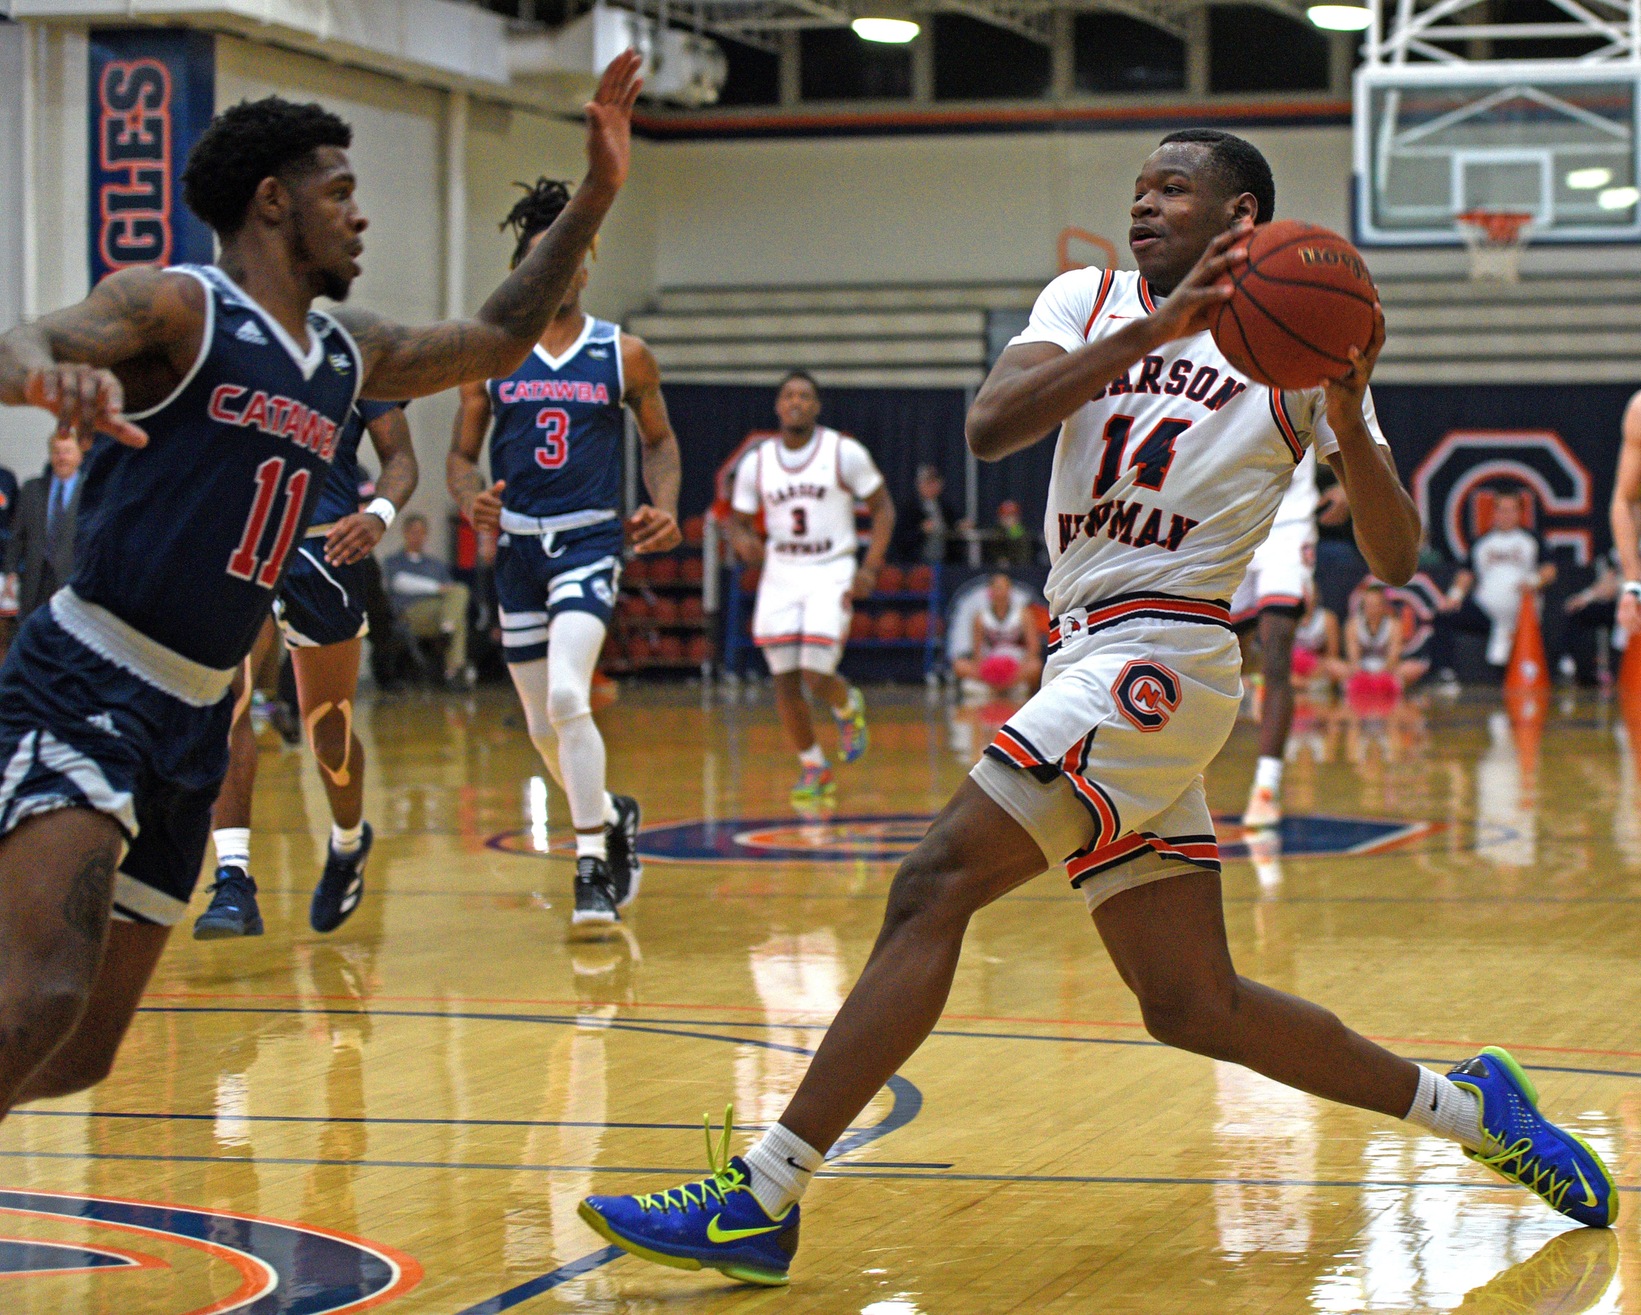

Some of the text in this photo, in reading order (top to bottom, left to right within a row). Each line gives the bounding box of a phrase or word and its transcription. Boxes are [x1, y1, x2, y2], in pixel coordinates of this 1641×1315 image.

[99, 59, 172, 271] GLES
[498, 380, 609, 405] CATAWBA
[1090, 354, 1247, 411] ARSON
[207, 384, 343, 463] CATAWB
[535, 407, 570, 469] 3
[1092, 414, 1193, 499] 14
[226, 456, 311, 589] 11
[791, 506, 808, 536] 3
